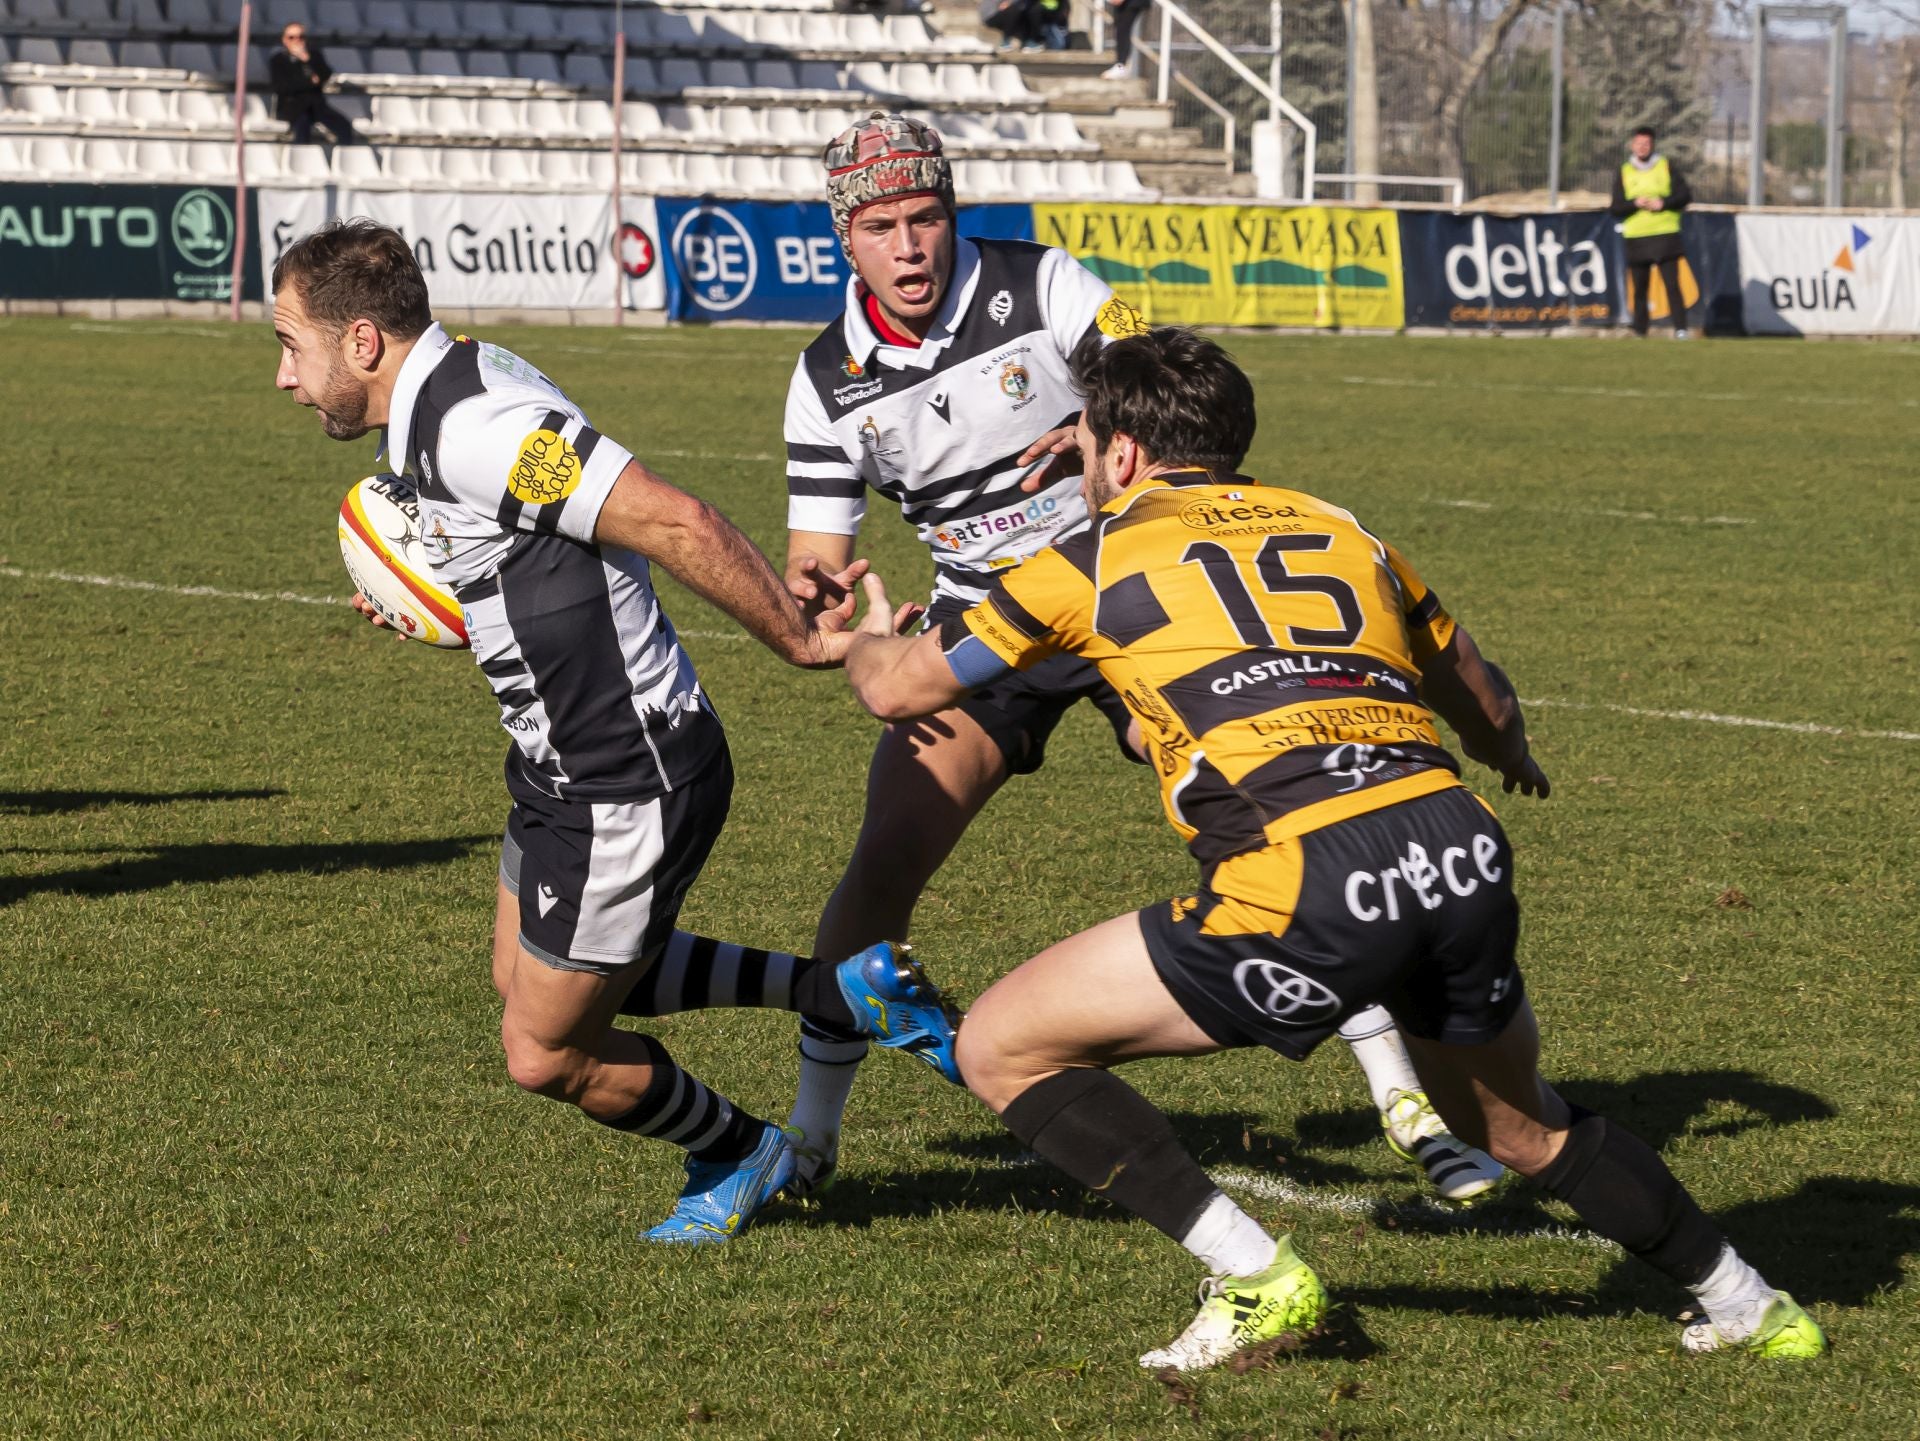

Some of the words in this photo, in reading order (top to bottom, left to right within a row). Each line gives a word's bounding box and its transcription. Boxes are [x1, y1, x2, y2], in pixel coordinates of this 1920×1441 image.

[0, 206, 158, 247] AUTO
[446, 222, 598, 274] Galicia
[1048, 211, 1211, 254] NEVASA
[1228, 215, 1390, 257] NEVASA
[684, 234, 747, 282] BE
[775, 236, 839, 284] BE
[1445, 215, 1608, 300] delta
[1769, 270, 1856, 311] GUÍA
[1198, 504, 1310, 526] itesa
[1208, 522, 1305, 538] ventanas
[1178, 534, 1367, 649] 15
[986, 625, 1023, 657] BURGO
[1234, 1296, 1280, 1350] adidas
